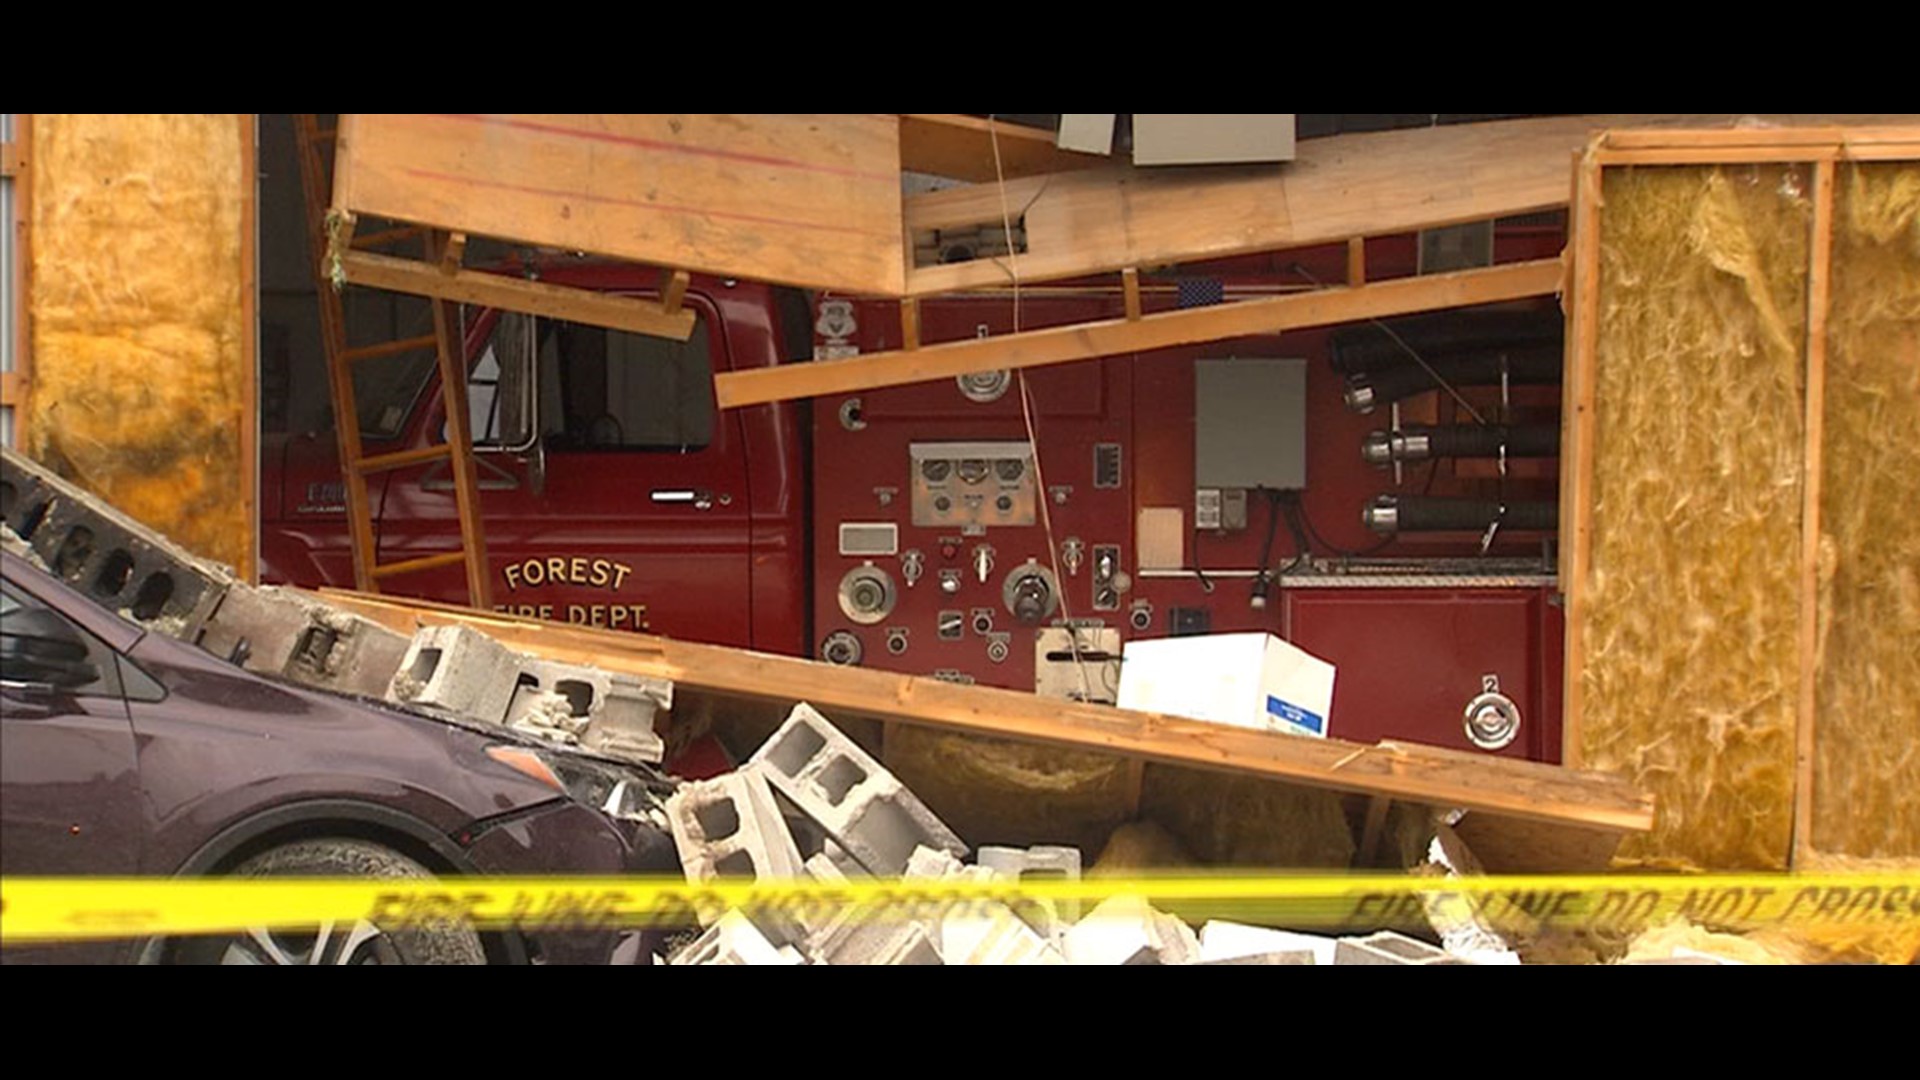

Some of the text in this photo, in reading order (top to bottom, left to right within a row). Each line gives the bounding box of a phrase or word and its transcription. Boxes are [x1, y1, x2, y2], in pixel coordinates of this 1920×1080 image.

[504, 557, 632, 590] FOREST
[567, 604, 650, 629] DEPT.
[1485, 677, 1496, 693] 2
[370, 891, 493, 925] FIRE
[508, 891, 635, 924] LINE
[1348, 891, 1460, 925] FIRE
[1474, 890, 1583, 924] LINE
[1590, 888, 1661, 924] DO
[1678, 887, 1776, 922] NOT
